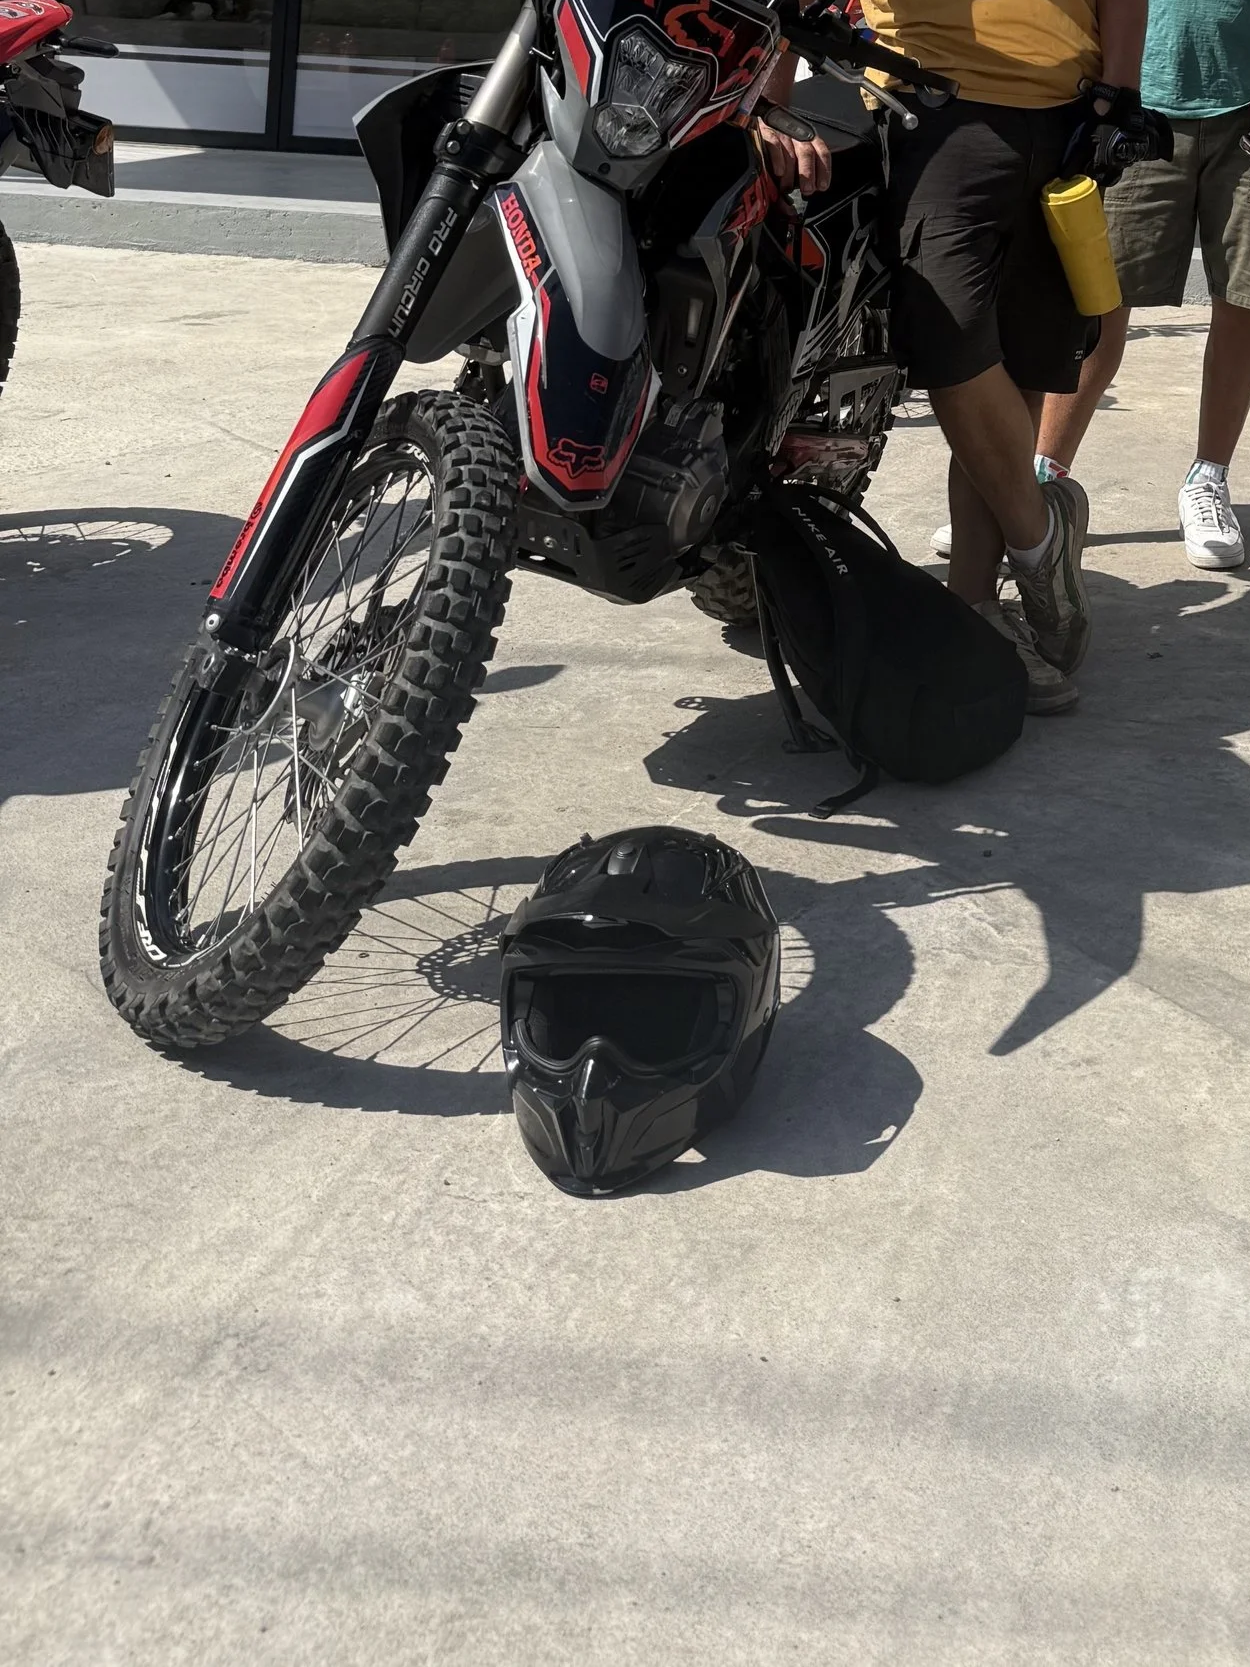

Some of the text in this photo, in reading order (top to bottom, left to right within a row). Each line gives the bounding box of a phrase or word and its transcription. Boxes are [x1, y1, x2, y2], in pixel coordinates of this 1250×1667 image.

[501, 191, 543, 279] HONDA
[387, 206, 458, 338] PRO CIRCUIT
[215, 520, 255, 589] brembo
[791, 506, 849, 576] NIKE AIR
[136, 920, 168, 961] CRF
